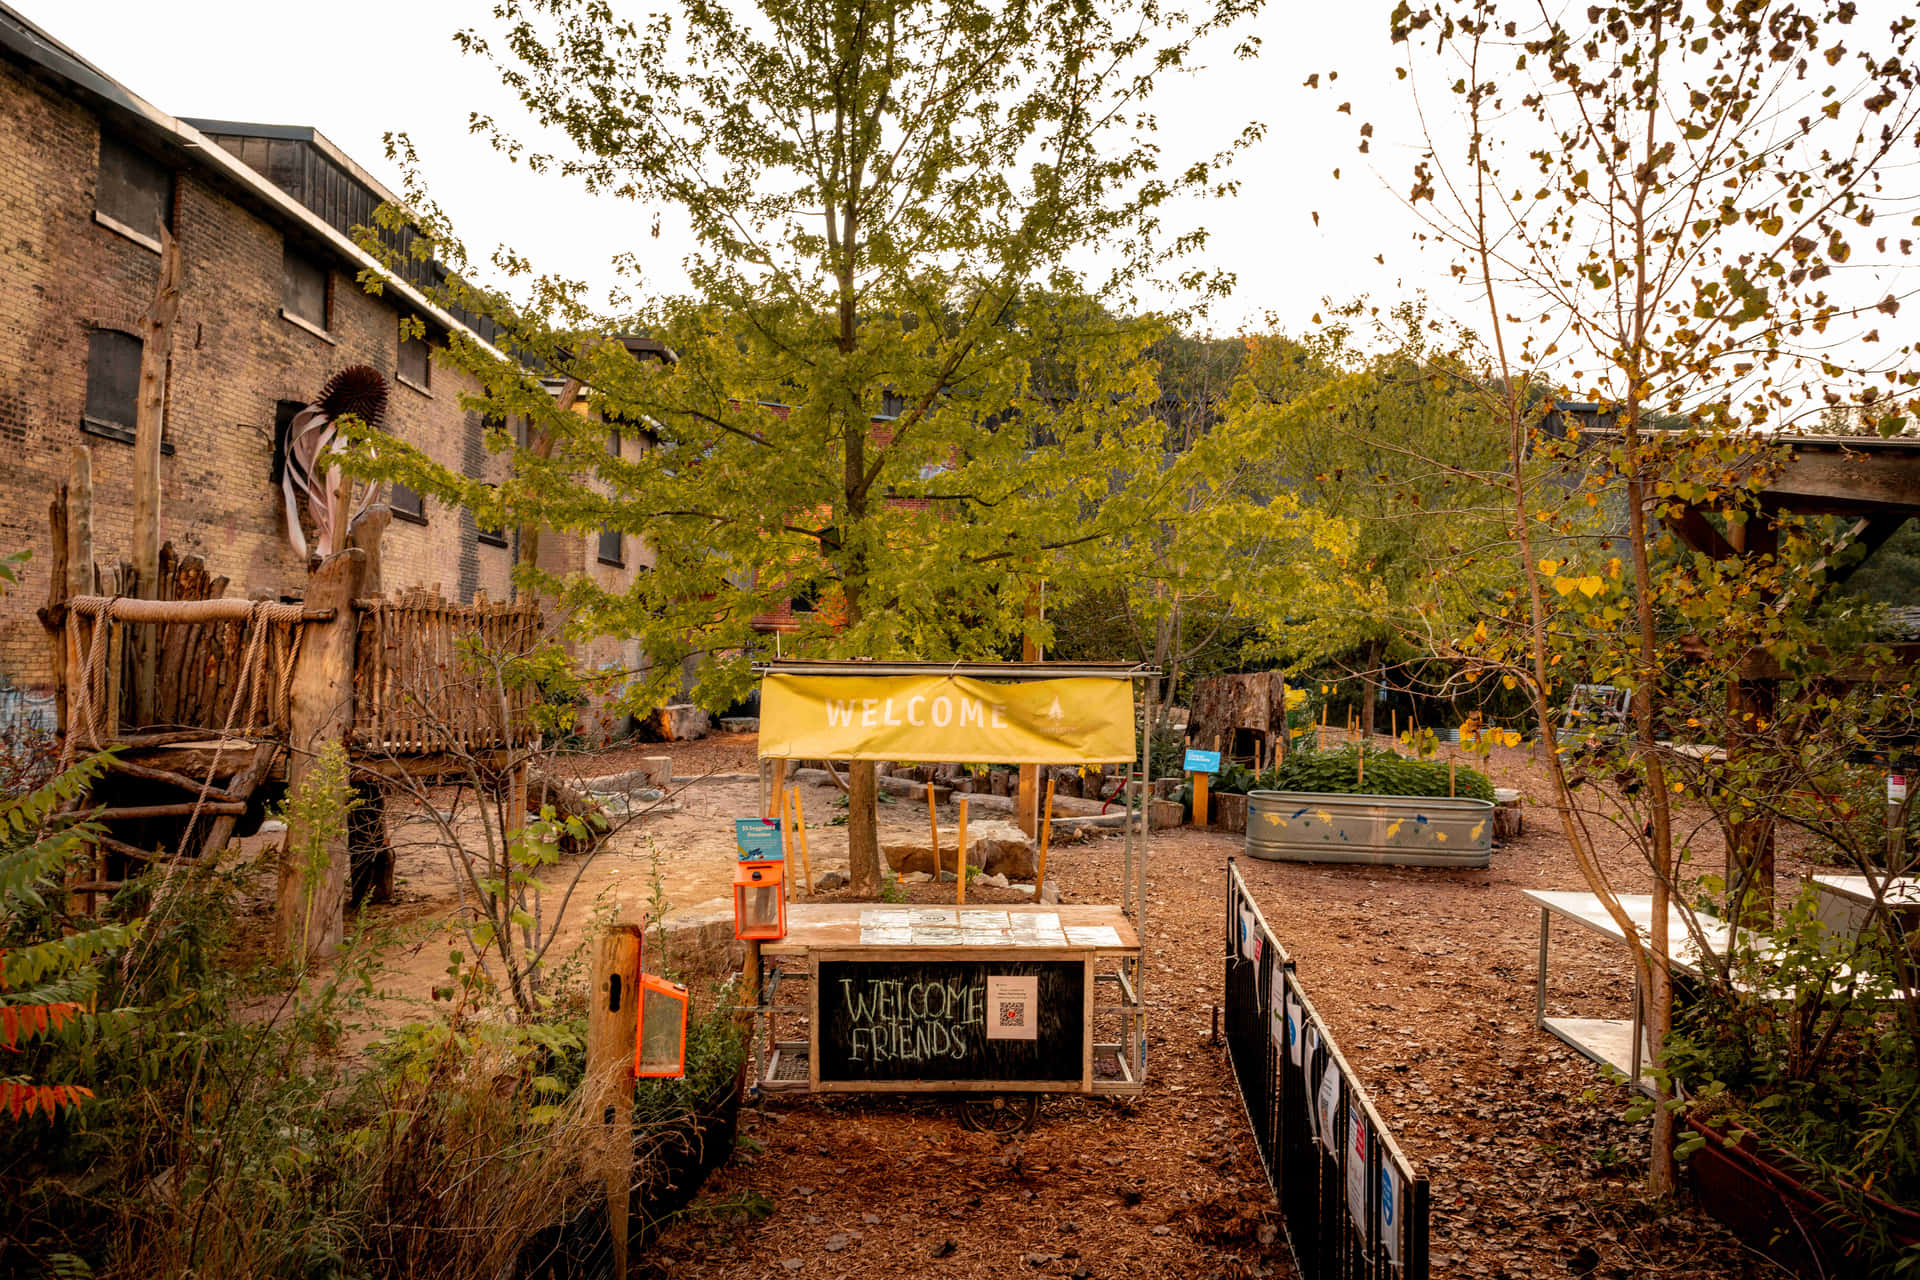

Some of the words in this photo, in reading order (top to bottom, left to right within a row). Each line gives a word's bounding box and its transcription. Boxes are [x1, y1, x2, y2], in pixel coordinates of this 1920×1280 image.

[826, 697, 1009, 729] WELCOME
[839, 979, 985, 1025] WELCOME
[848, 1022, 968, 1060] FRIENDS
